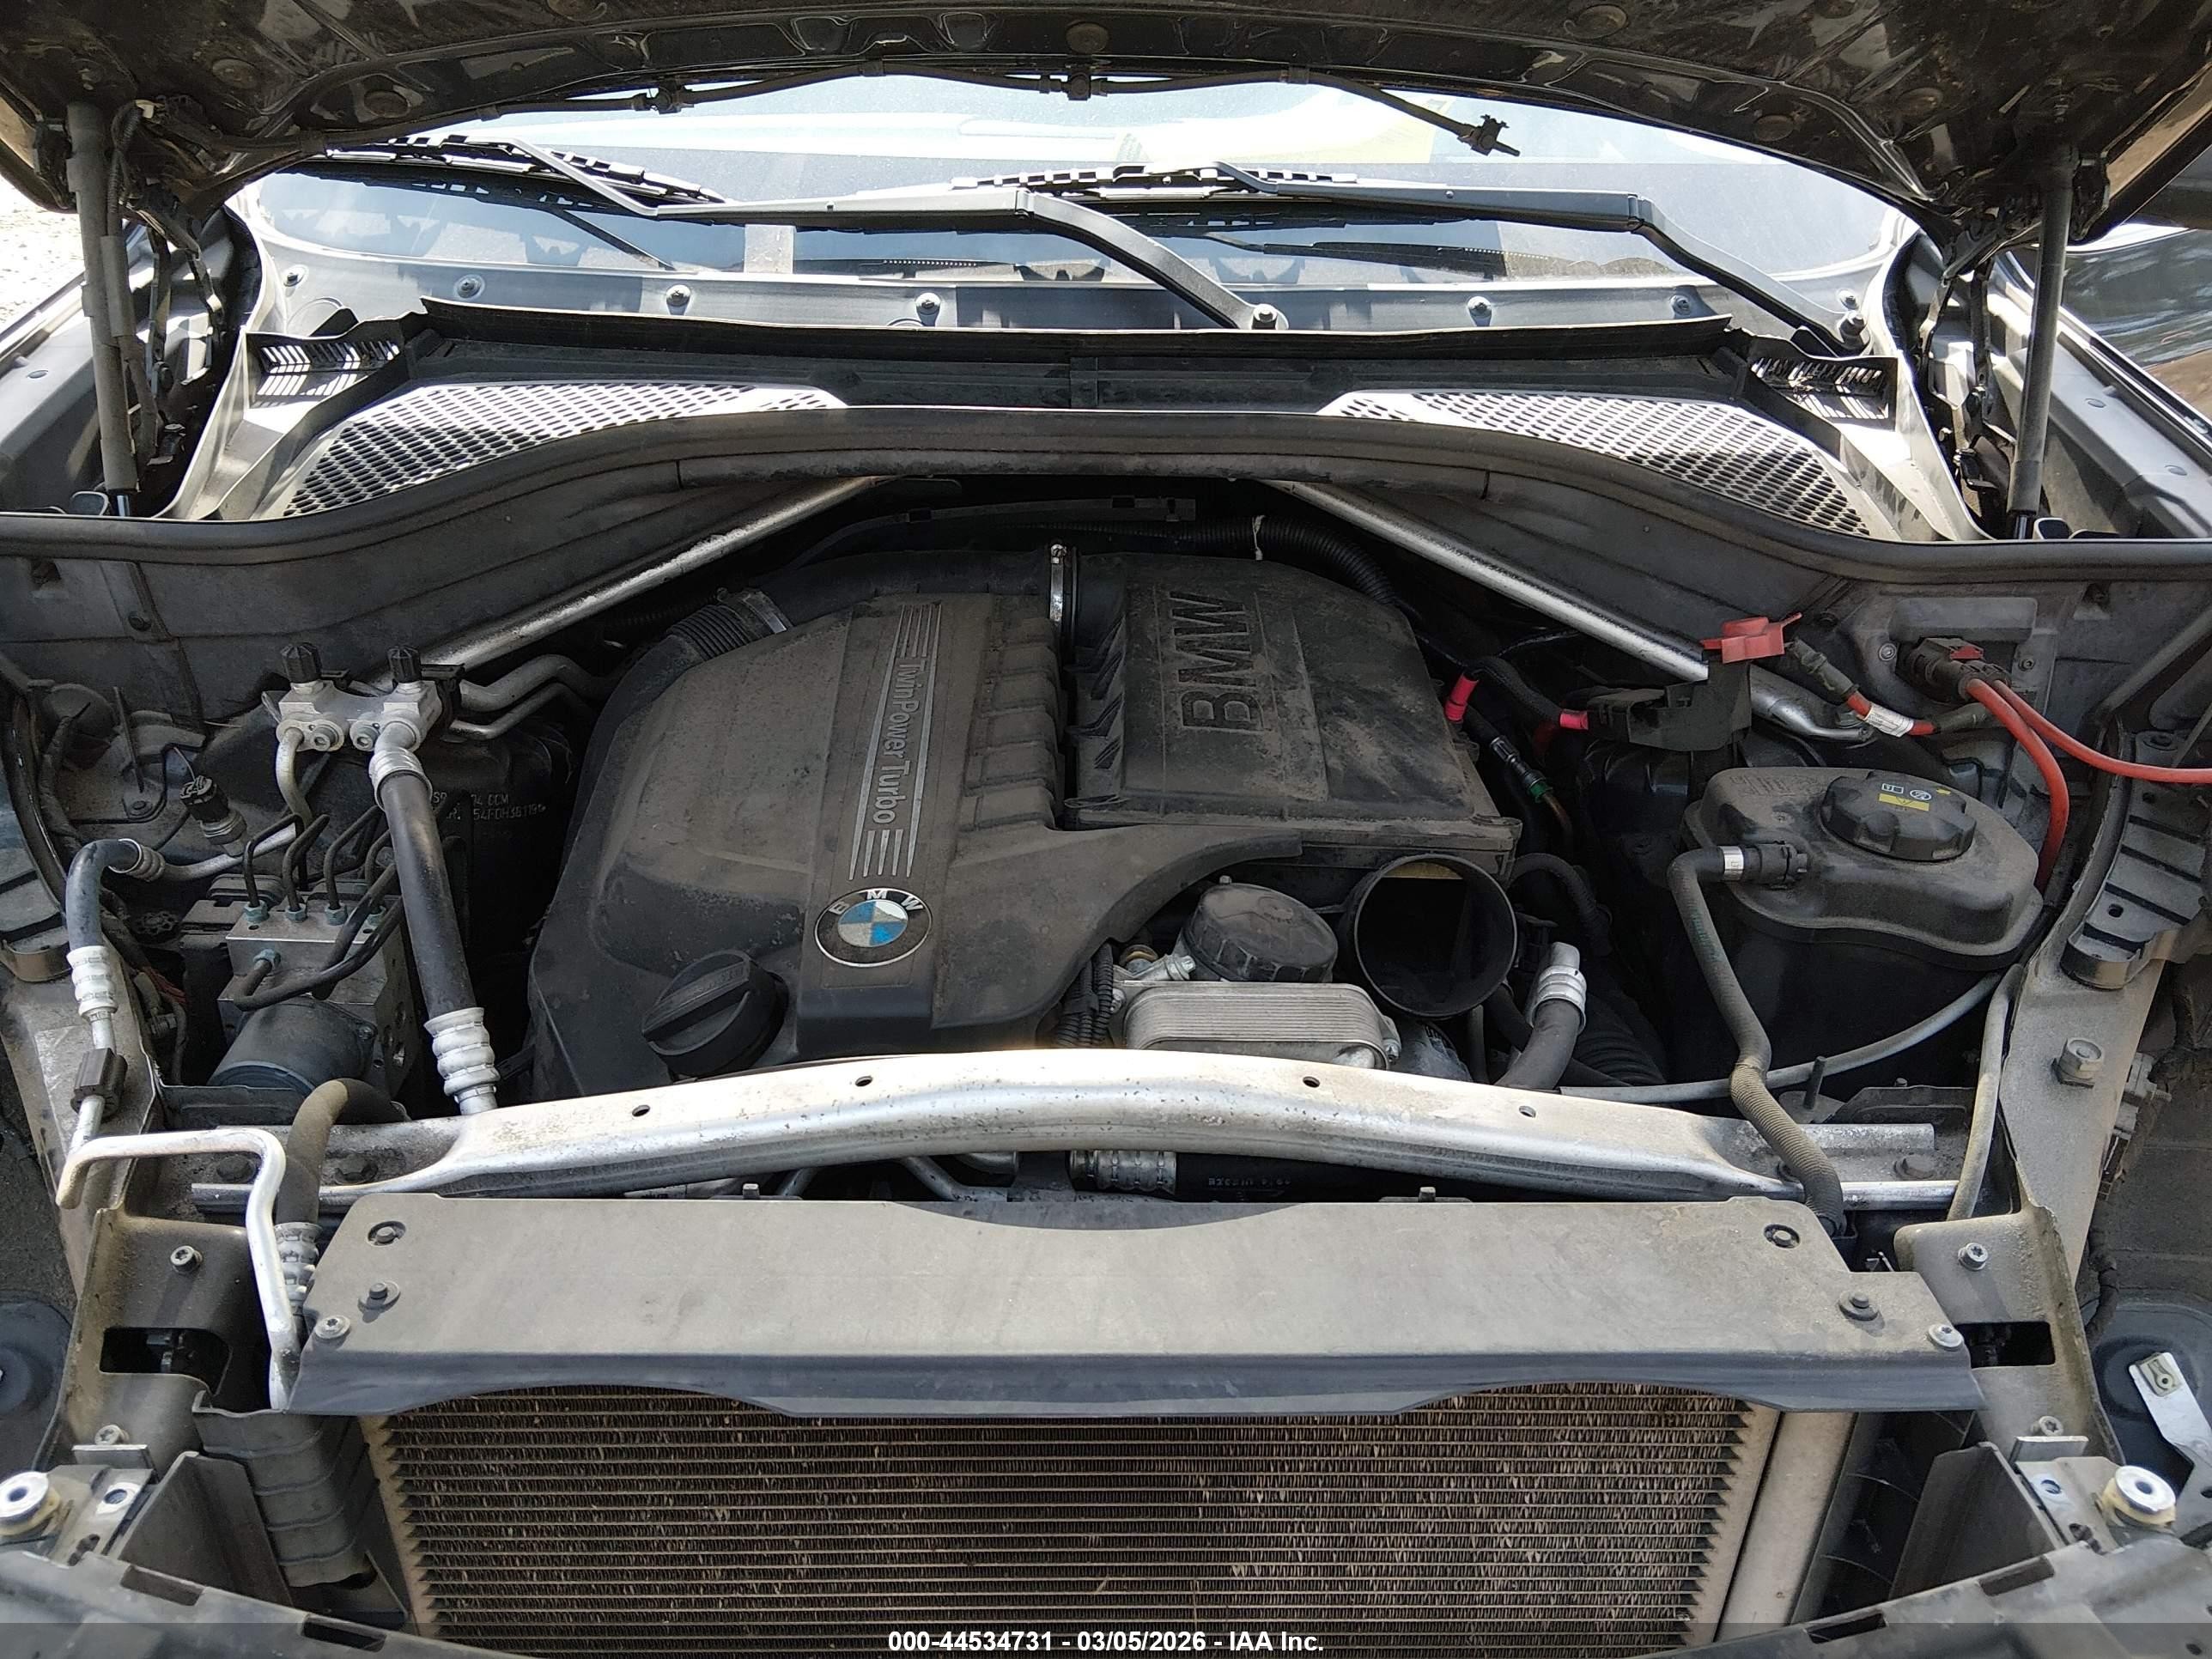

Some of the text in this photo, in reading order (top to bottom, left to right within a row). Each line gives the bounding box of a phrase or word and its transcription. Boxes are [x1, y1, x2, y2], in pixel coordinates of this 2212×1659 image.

[1170, 590, 1264, 732] BMW
[872, 659, 927, 824] TwinPower Turbo
[829, 890, 924, 915] BMW
